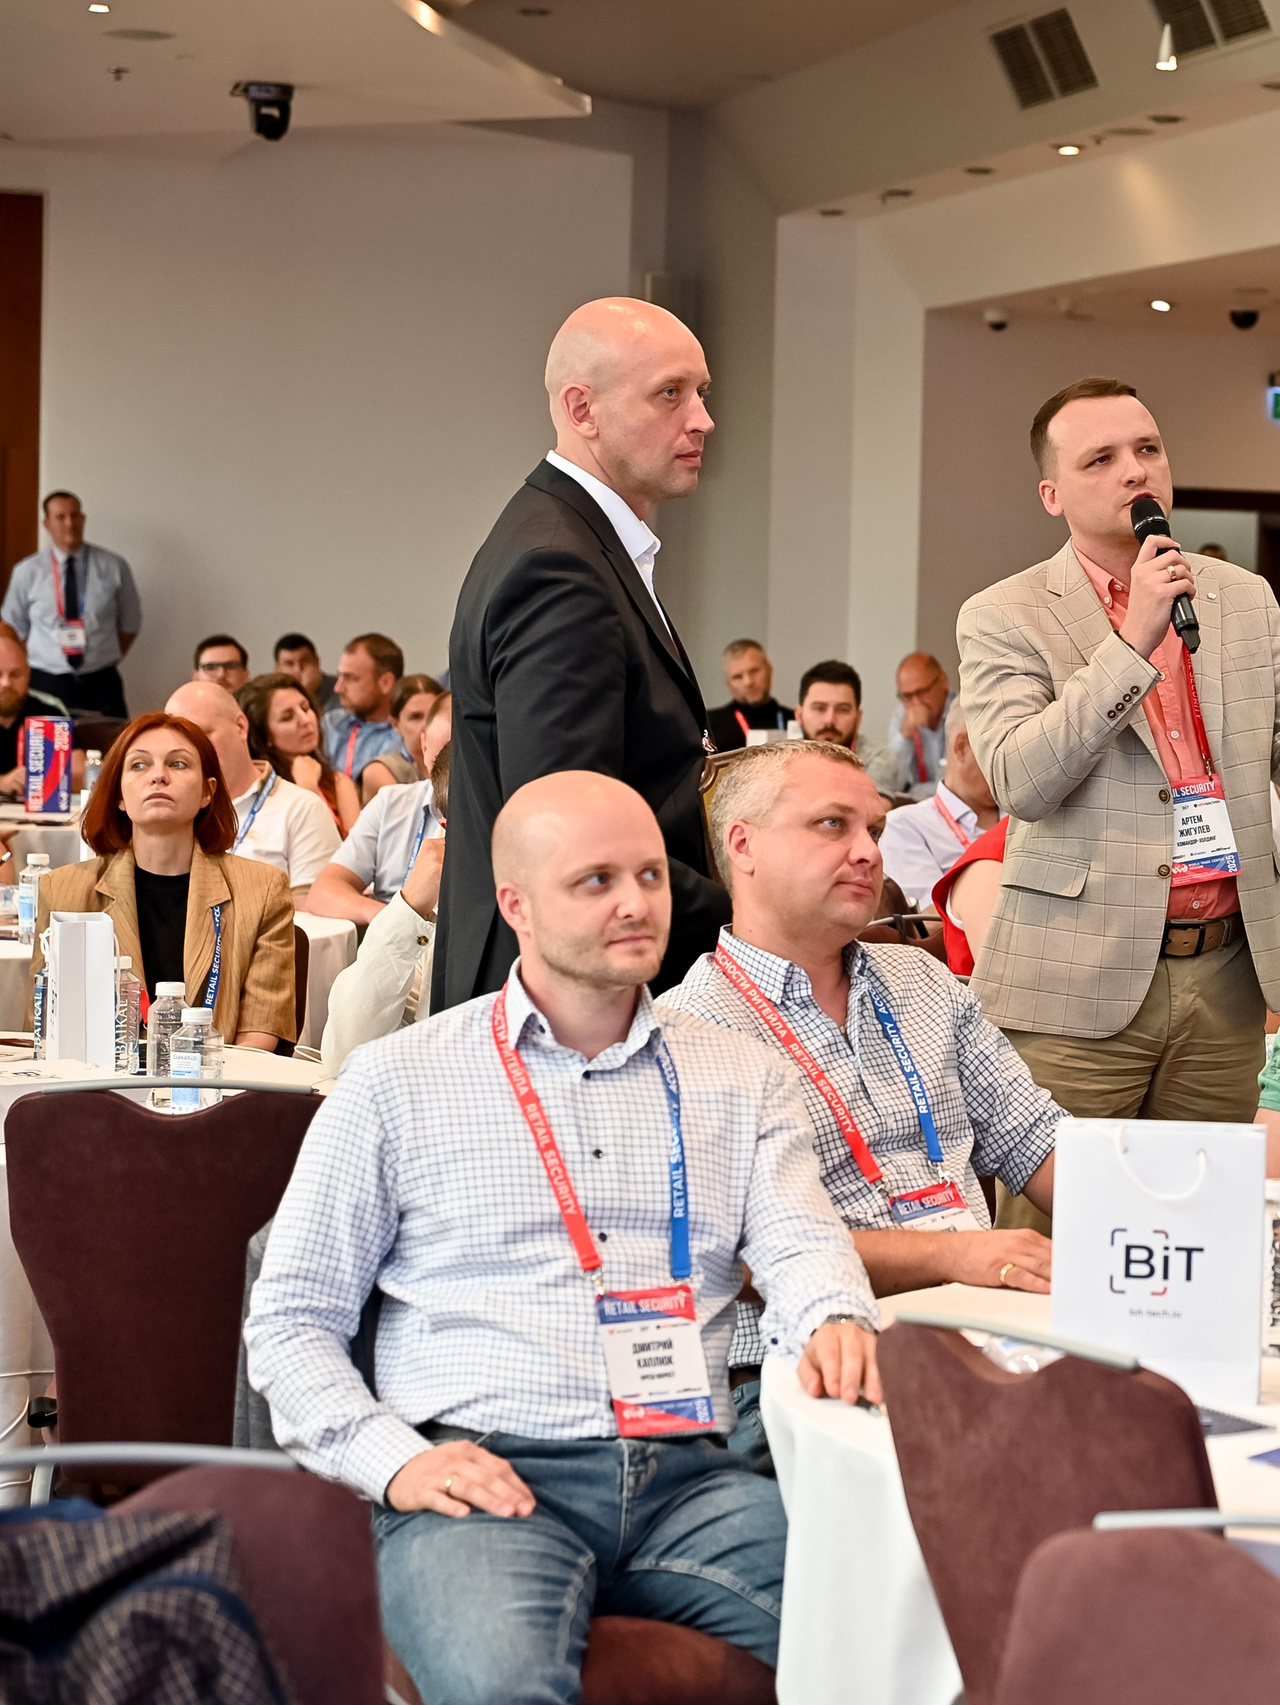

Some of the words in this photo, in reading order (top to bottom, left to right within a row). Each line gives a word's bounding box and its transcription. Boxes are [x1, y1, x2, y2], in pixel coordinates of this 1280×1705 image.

[1180, 781, 1216, 796] SECURITY
[1178, 824, 1211, 838] ЖИГУЛЕВ
[1181, 814, 1204, 826] АРТЕМ
[1225, 854, 1238, 873] 2025
[205, 976, 218, 1005] RETAIL
[212, 932, 222, 975] SECURITY
[748, 986, 787, 1039] РИТЕЙЛА
[884, 1021, 915, 1076] SECURITY
[788, 1042, 820, 1080] RETAIL
[817, 1079, 856, 1134] SECURITY
[908, 1075, 929, 1115] RETAIL
[525, 1102, 552, 1147] RETAIL
[543, 1149, 578, 1216] SECURITY
[671, 1165, 685, 1218] RETAIL
[922, 1189, 956, 1210] SECURITY
[1124, 1244, 1205, 1282] BiT
[603, 1299, 639, 1316] RETAIL
[638, 1293, 687, 1314] SECURITY
